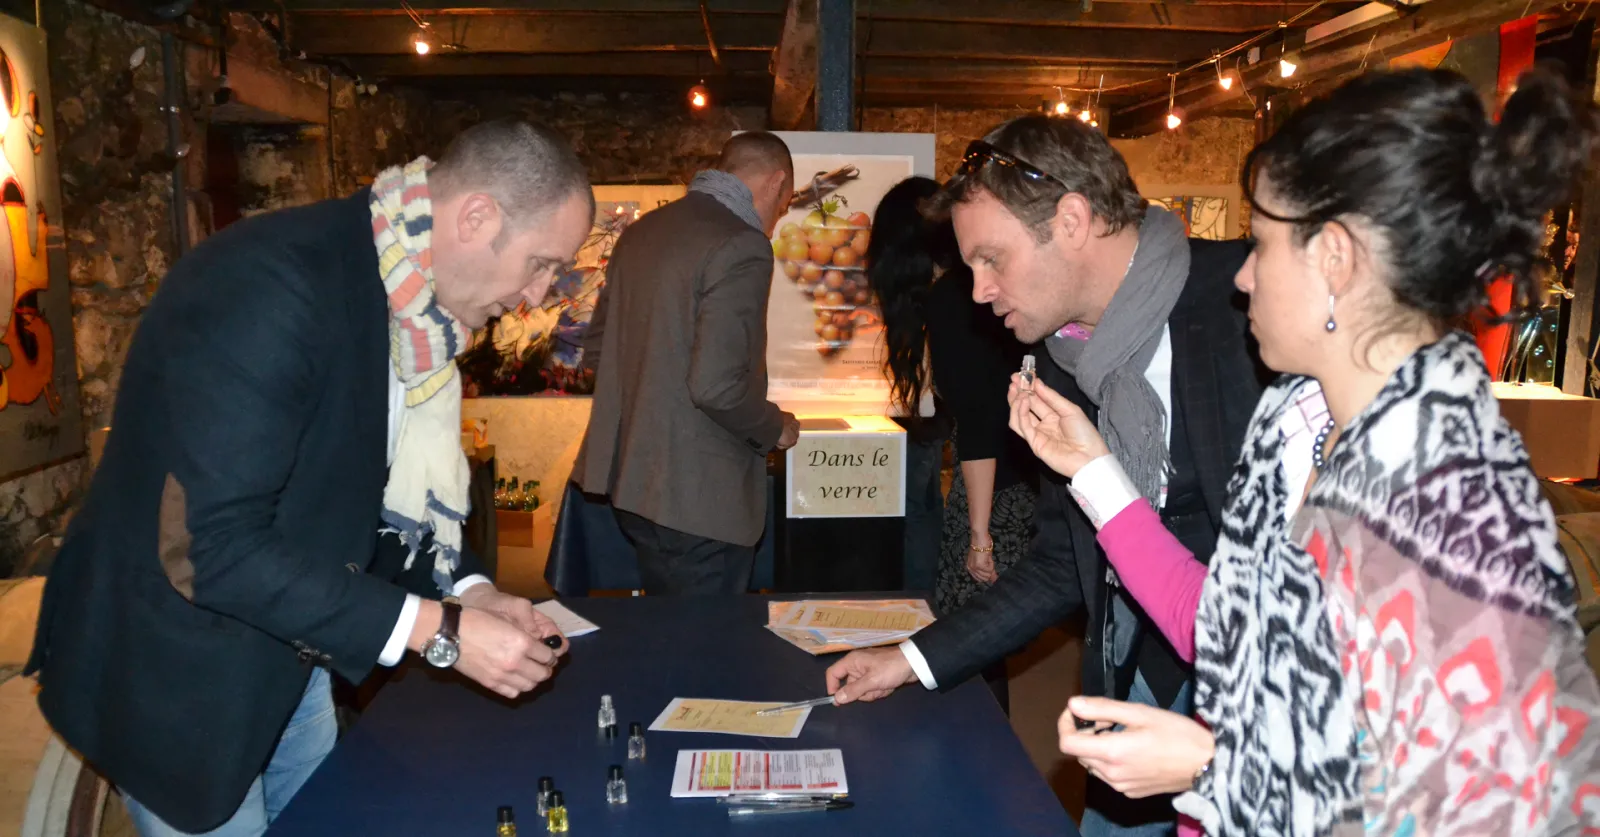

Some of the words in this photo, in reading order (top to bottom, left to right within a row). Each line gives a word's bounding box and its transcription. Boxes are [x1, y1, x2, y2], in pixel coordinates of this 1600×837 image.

[808, 450, 865, 467] Dans
[872, 448, 889, 467] le
[818, 485, 878, 499] verre
